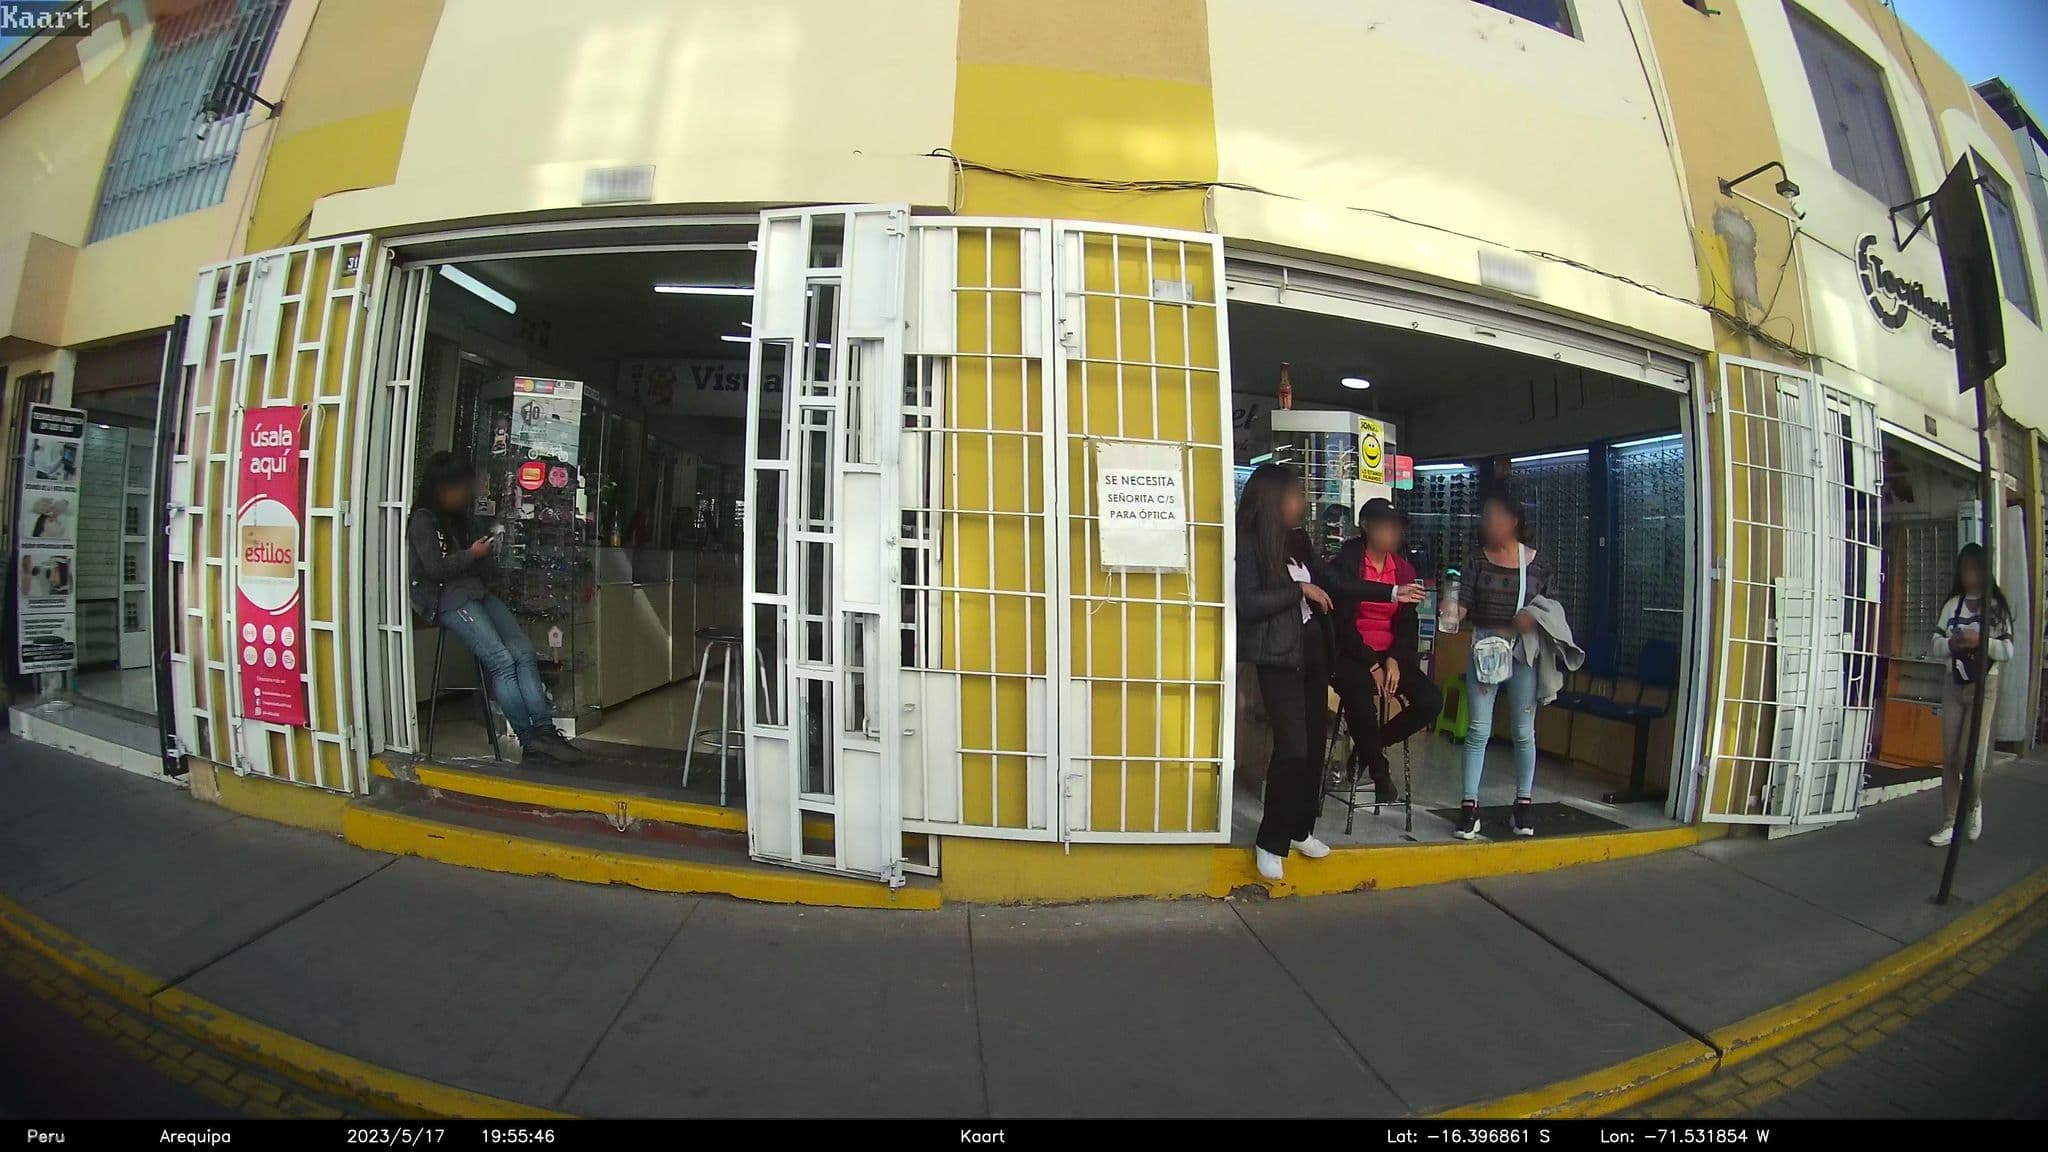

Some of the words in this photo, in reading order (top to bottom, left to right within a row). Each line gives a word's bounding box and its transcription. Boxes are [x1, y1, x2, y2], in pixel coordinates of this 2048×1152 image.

[251, 423, 293, 447] úsala
[250, 448, 291, 481] aquí
[1104, 475, 1118, 485] SE
[1121, 475, 1175, 487] NECESITA
[1107, 492, 1155, 504] SEÑORITA
[1157, 495, 1175, 505] C/S
[1109, 510, 1137, 520] PARA
[1139, 508, 1175, 520] ÓPTICA
[245, 542, 292, 565] estilos
